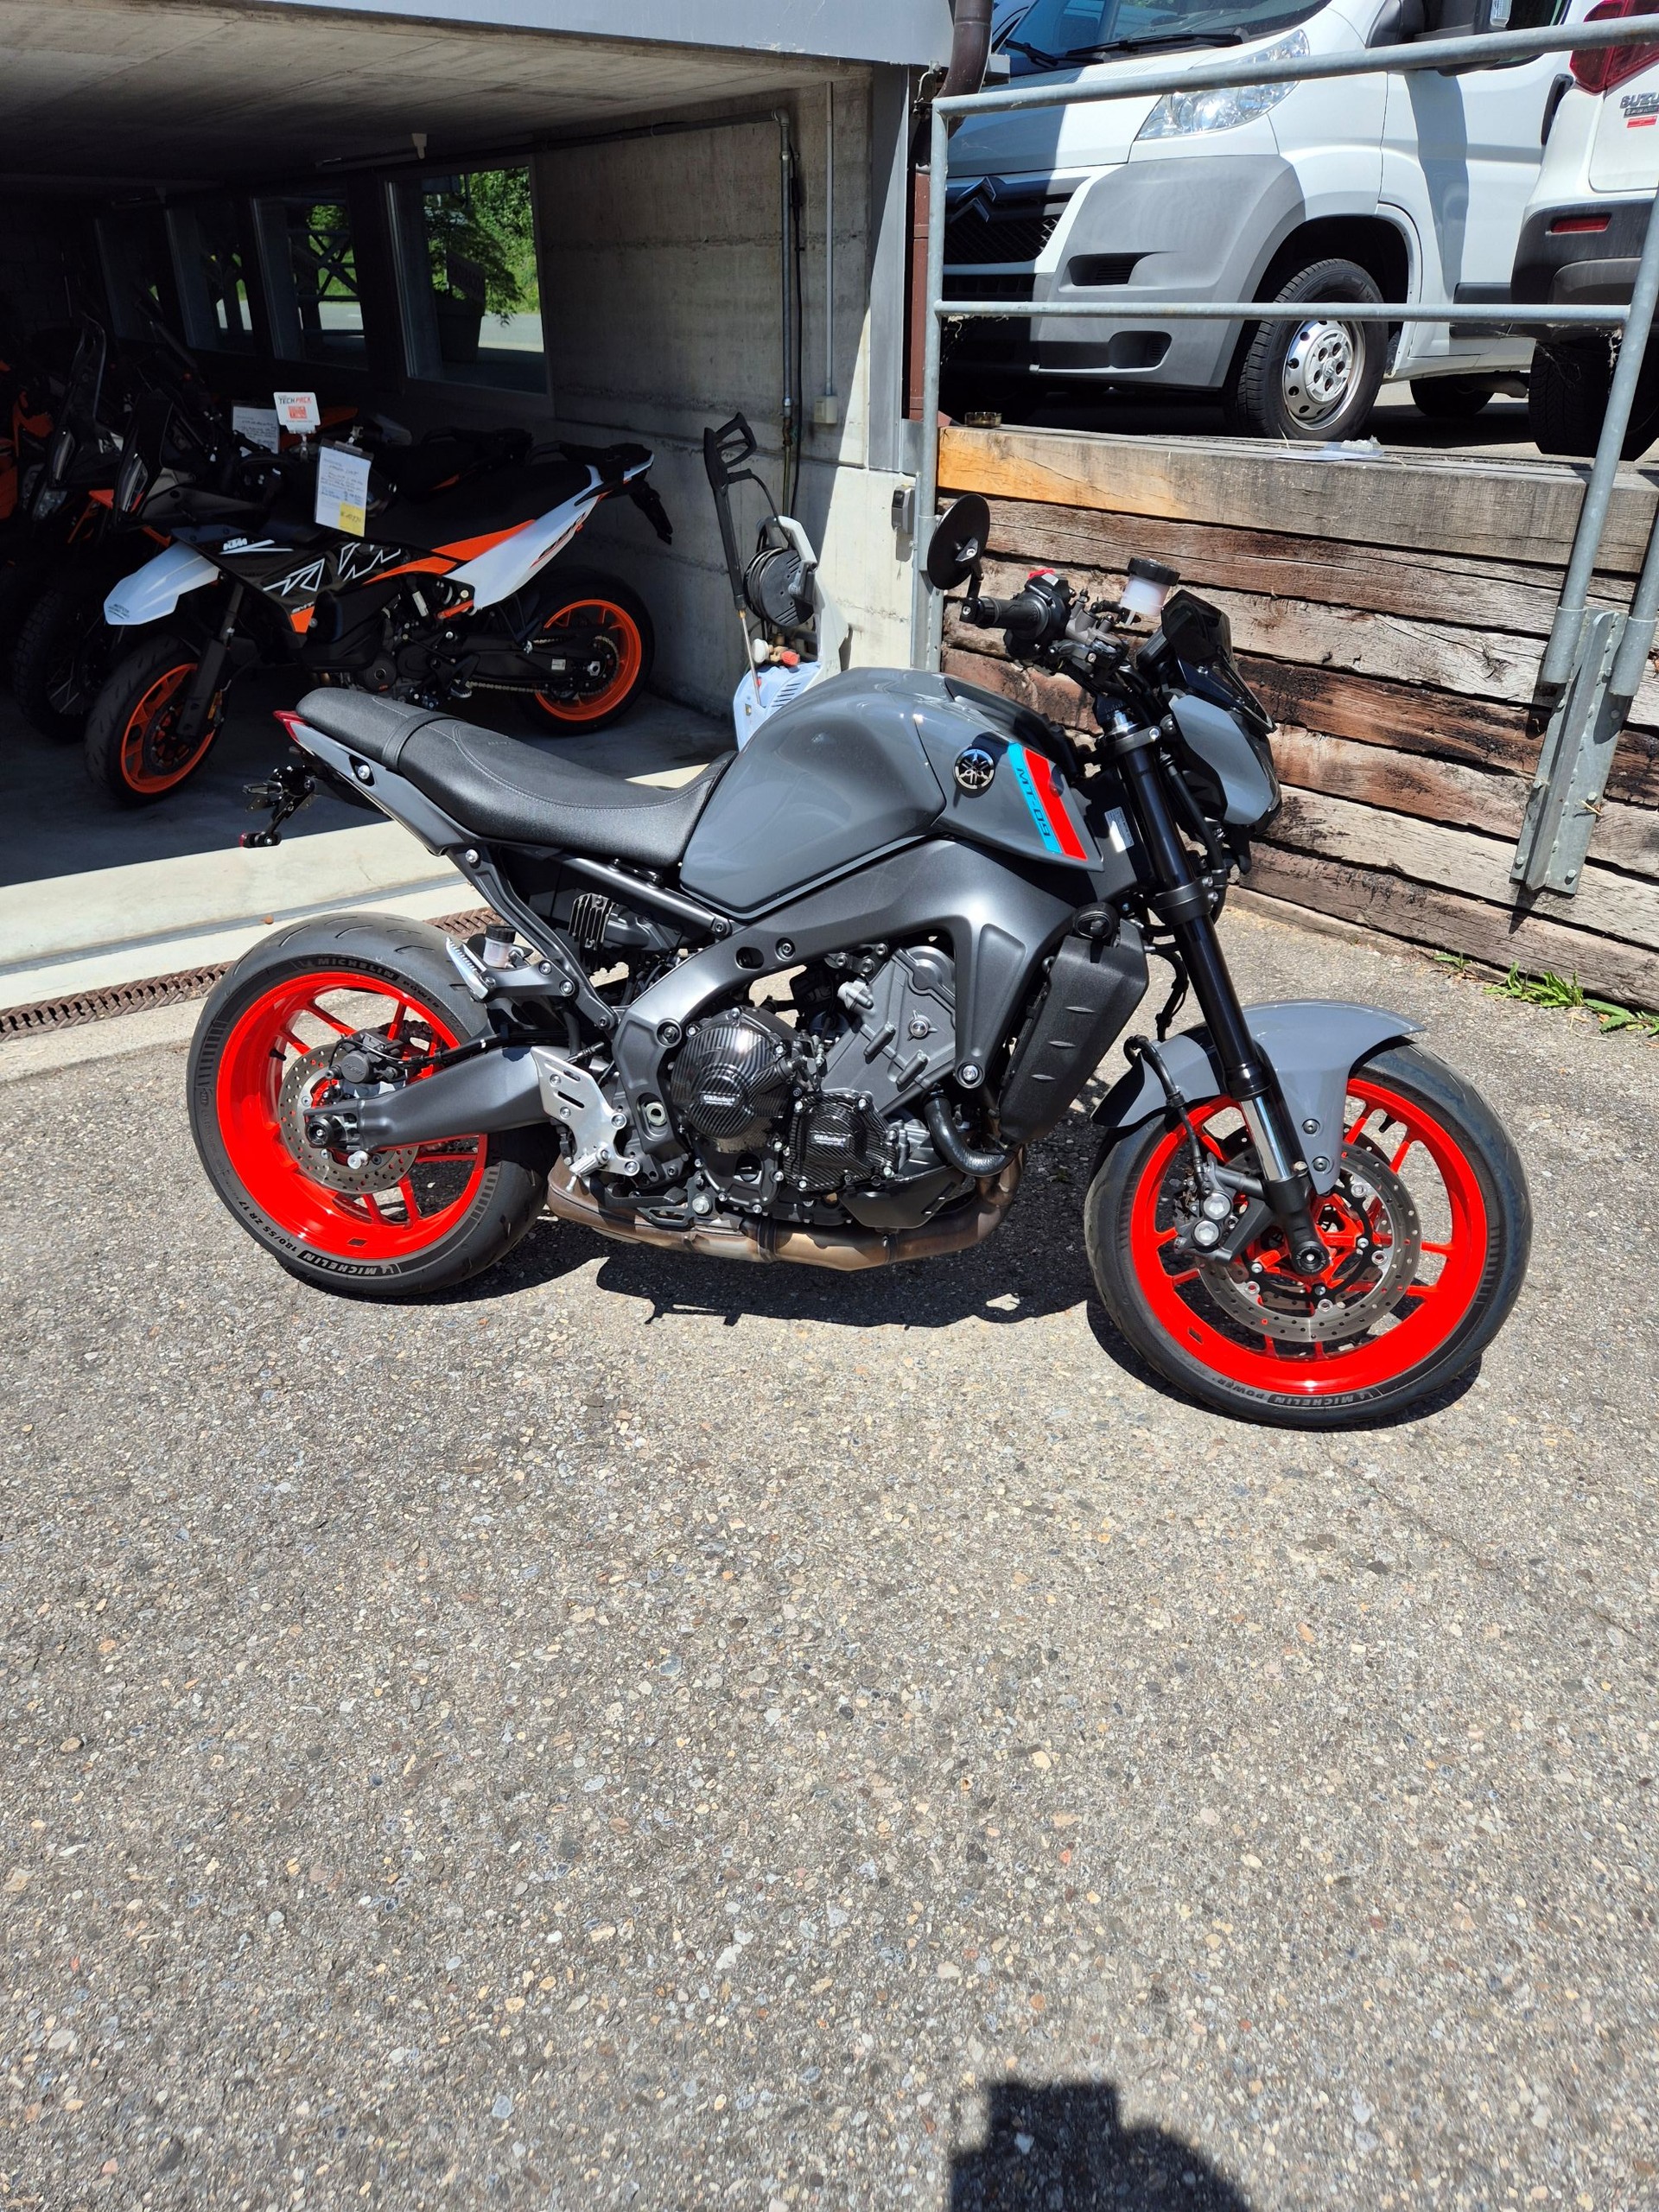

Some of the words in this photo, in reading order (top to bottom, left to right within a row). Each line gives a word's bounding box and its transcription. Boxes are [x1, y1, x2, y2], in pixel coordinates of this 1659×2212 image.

[223, 537, 248, 551] KTM
[1016, 767, 1052, 837] MT-09
[317, 957, 395, 981] MICHELIN
[403, 980, 440, 1008] POWER
[263, 1225, 298, 1252] 180/55
[303, 1252, 378, 1275] MICHELIN
[1217, 1377, 1265, 1401] POWER
[1274, 1393, 1354, 1407] MICHELIN
